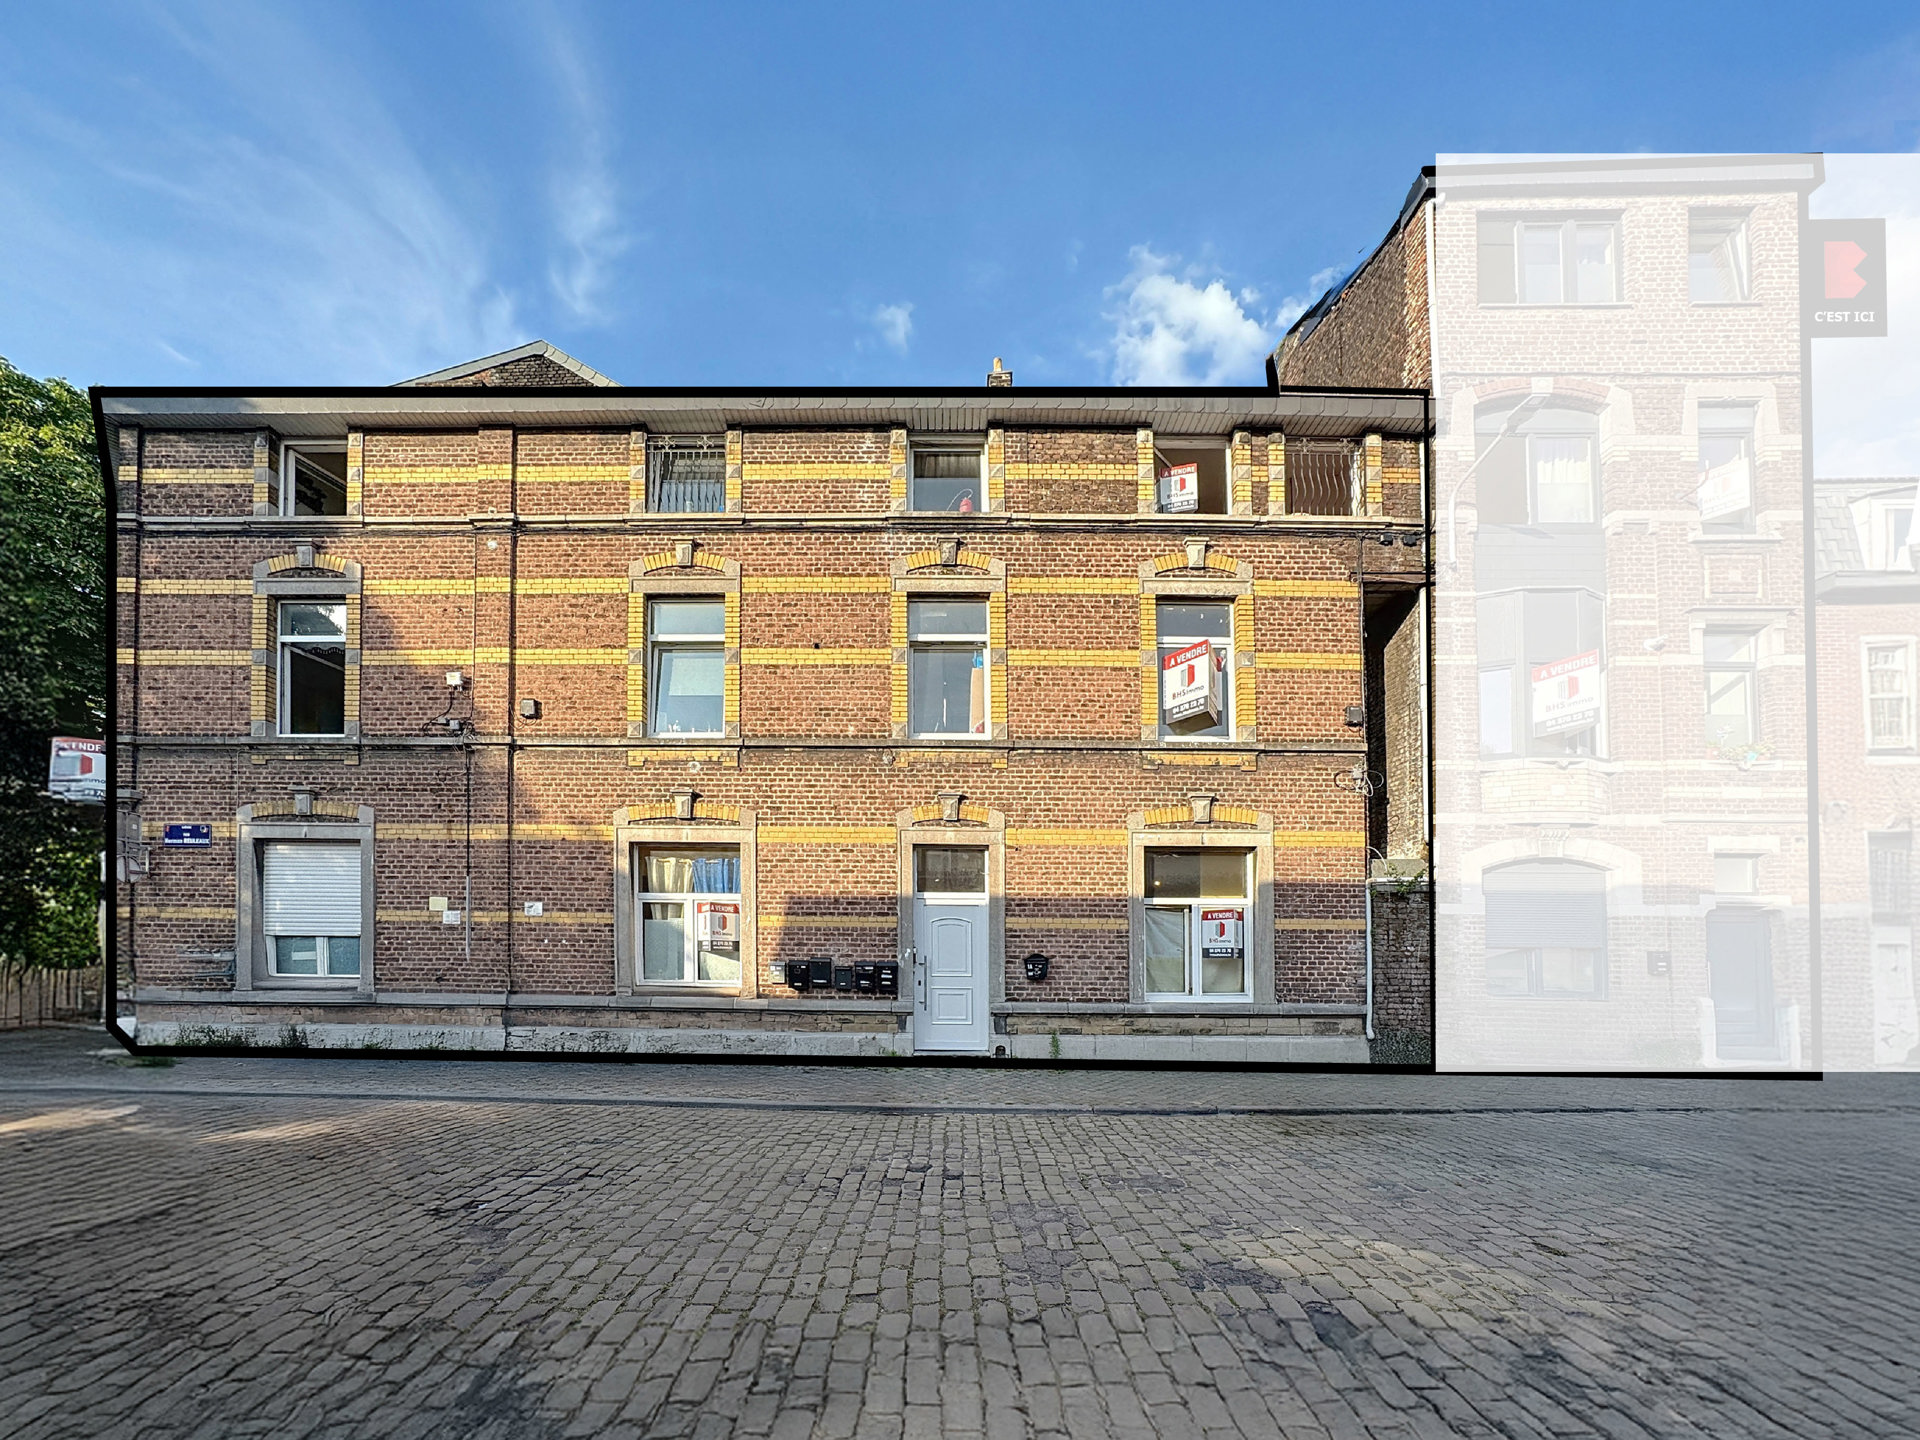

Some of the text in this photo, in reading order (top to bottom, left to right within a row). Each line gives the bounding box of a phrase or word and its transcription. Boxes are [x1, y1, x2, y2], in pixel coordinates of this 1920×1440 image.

[1171, 466, 1196, 476] VENDRE
[1169, 644, 1208, 667] A VENDRE
[1540, 655, 1597, 679] A VENDRE
